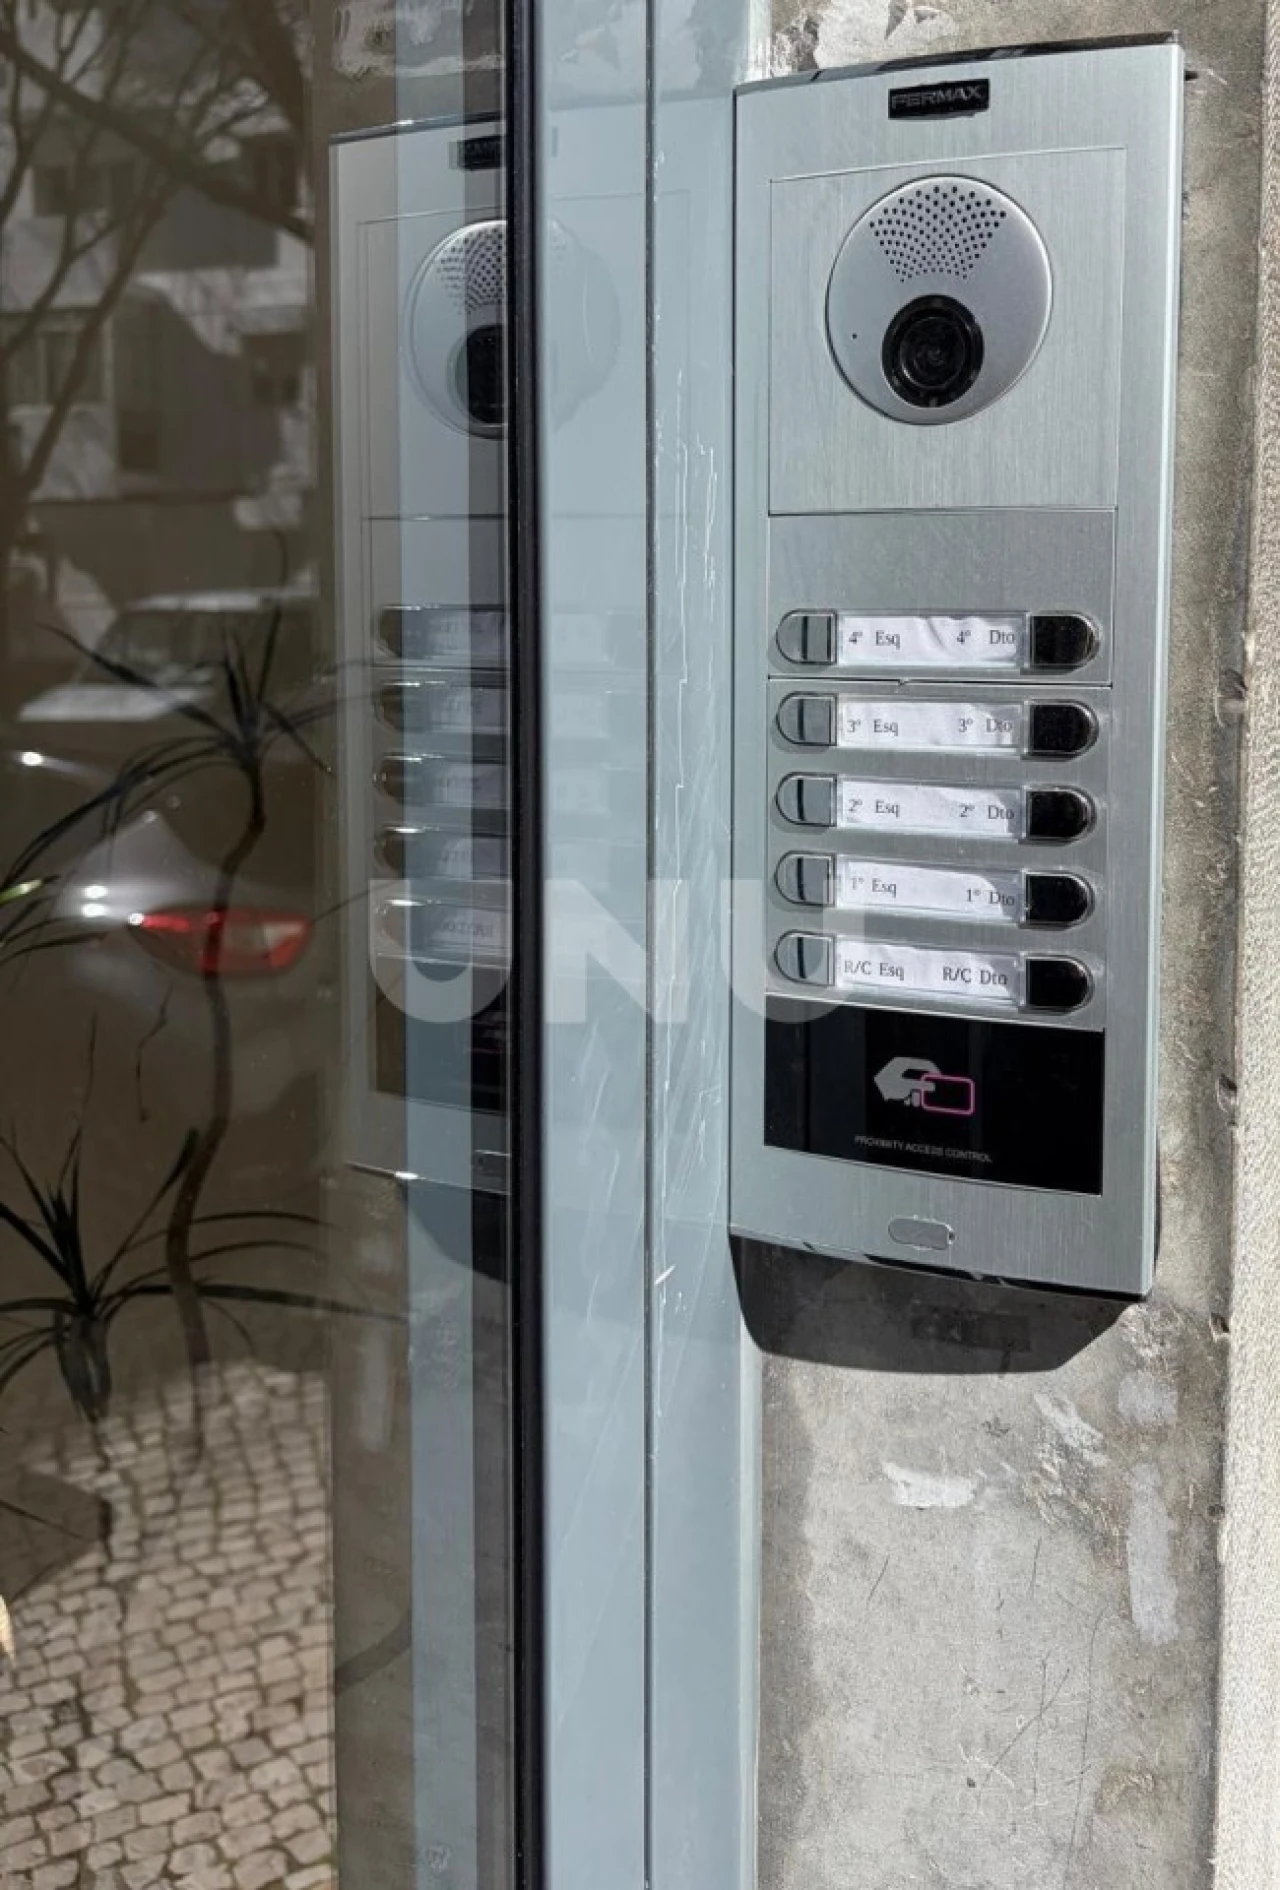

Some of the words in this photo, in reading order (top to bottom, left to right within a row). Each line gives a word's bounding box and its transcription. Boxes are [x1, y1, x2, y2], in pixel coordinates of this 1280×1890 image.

[875, 631, 901, 650] Esq
[989, 630, 1016, 645] Dto
[873, 719, 899, 737] Esq
[986, 719, 1013, 733] Dto
[875, 800, 901, 818] Esq
[988, 805, 1015, 820] Dto
[871, 878, 897, 898] Esq
[989, 890, 1015, 905] Dto
[844, 959, 872, 976] R/C
[879, 962, 905, 981] Esq
[943, 966, 972, 984] R/C
[980, 968, 1008, 985] Dto
[854, 1135, 903, 1150] PROXIMITY
[906, 1143, 944, 1157] ACCESS
[945, 1148, 992, 1163] CONTROL
